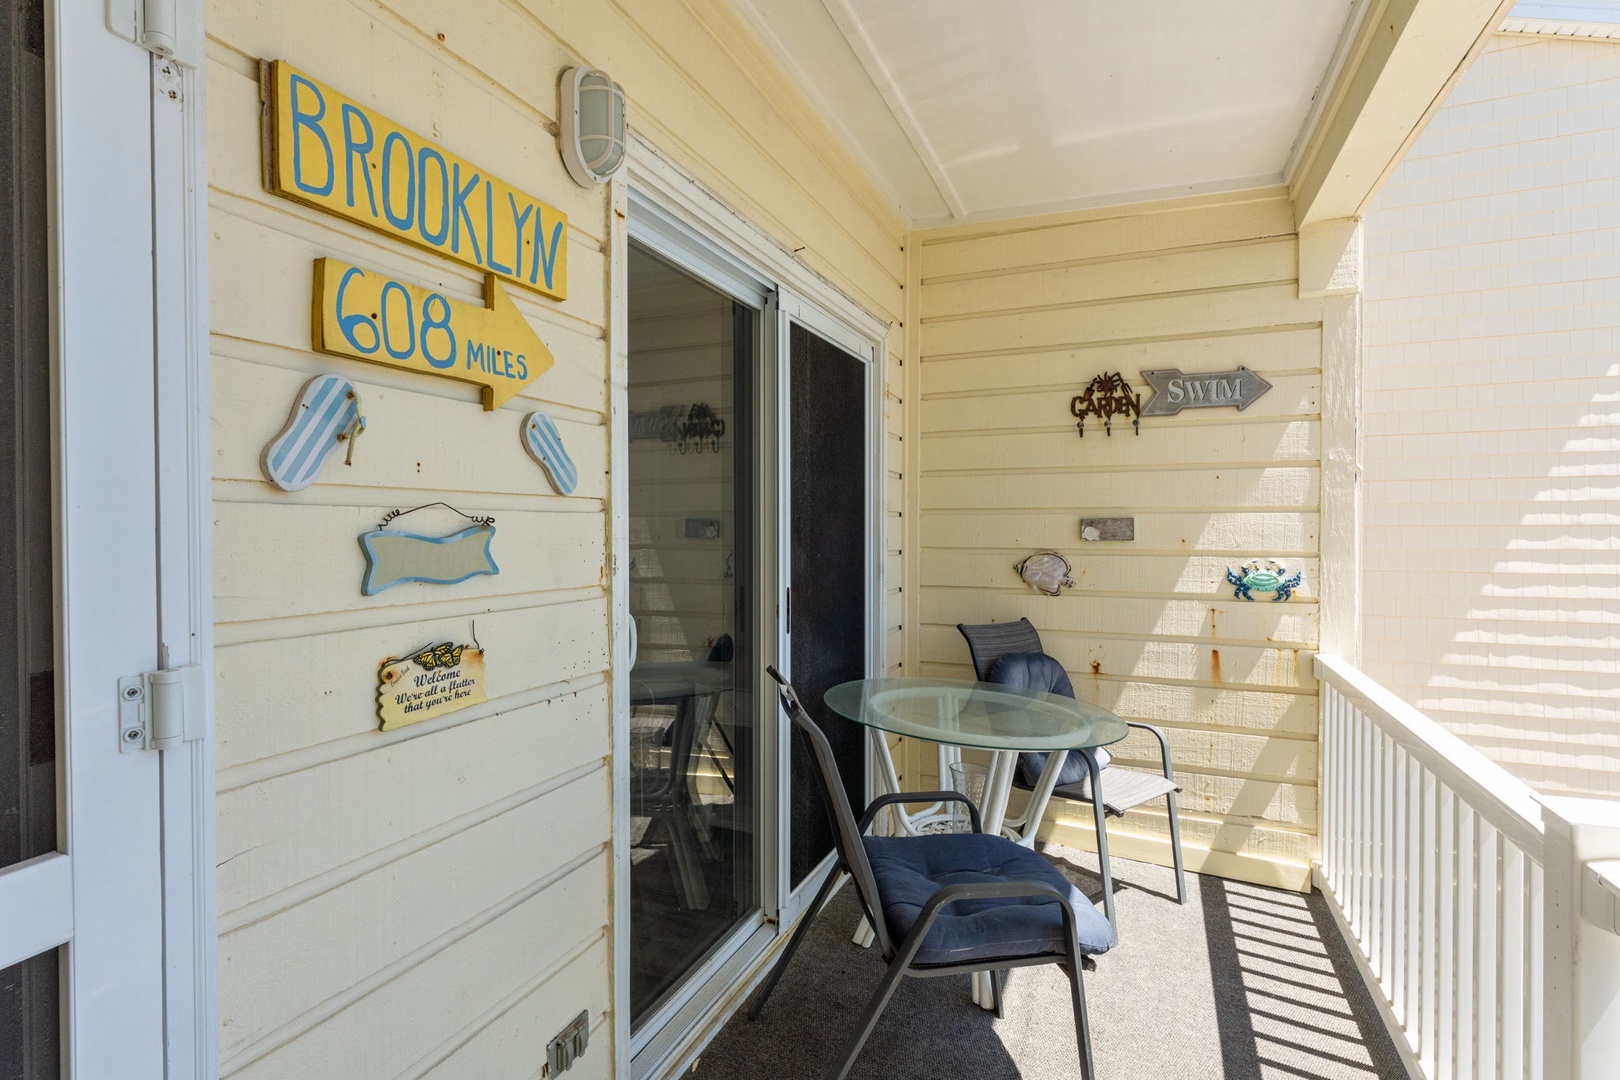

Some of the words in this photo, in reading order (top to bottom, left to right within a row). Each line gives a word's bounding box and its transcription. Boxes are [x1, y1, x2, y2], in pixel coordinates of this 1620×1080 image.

[290, 73, 563, 290] BROOKLYN
[336, 267, 457, 369] 608
[466, 339, 528, 381] MILES
[1168, 378, 1242, 403] SWIM
[1071, 393, 1141, 419] GARDEN
[395, 692, 422, 705] We're
[424, 686, 438, 698] all
[449, 679, 476, 694] flutter
[413, 670, 461, 688] Welcome
[404, 703, 423, 714] that
[426, 694, 453, 710] you're
[454, 689, 472, 699] here
